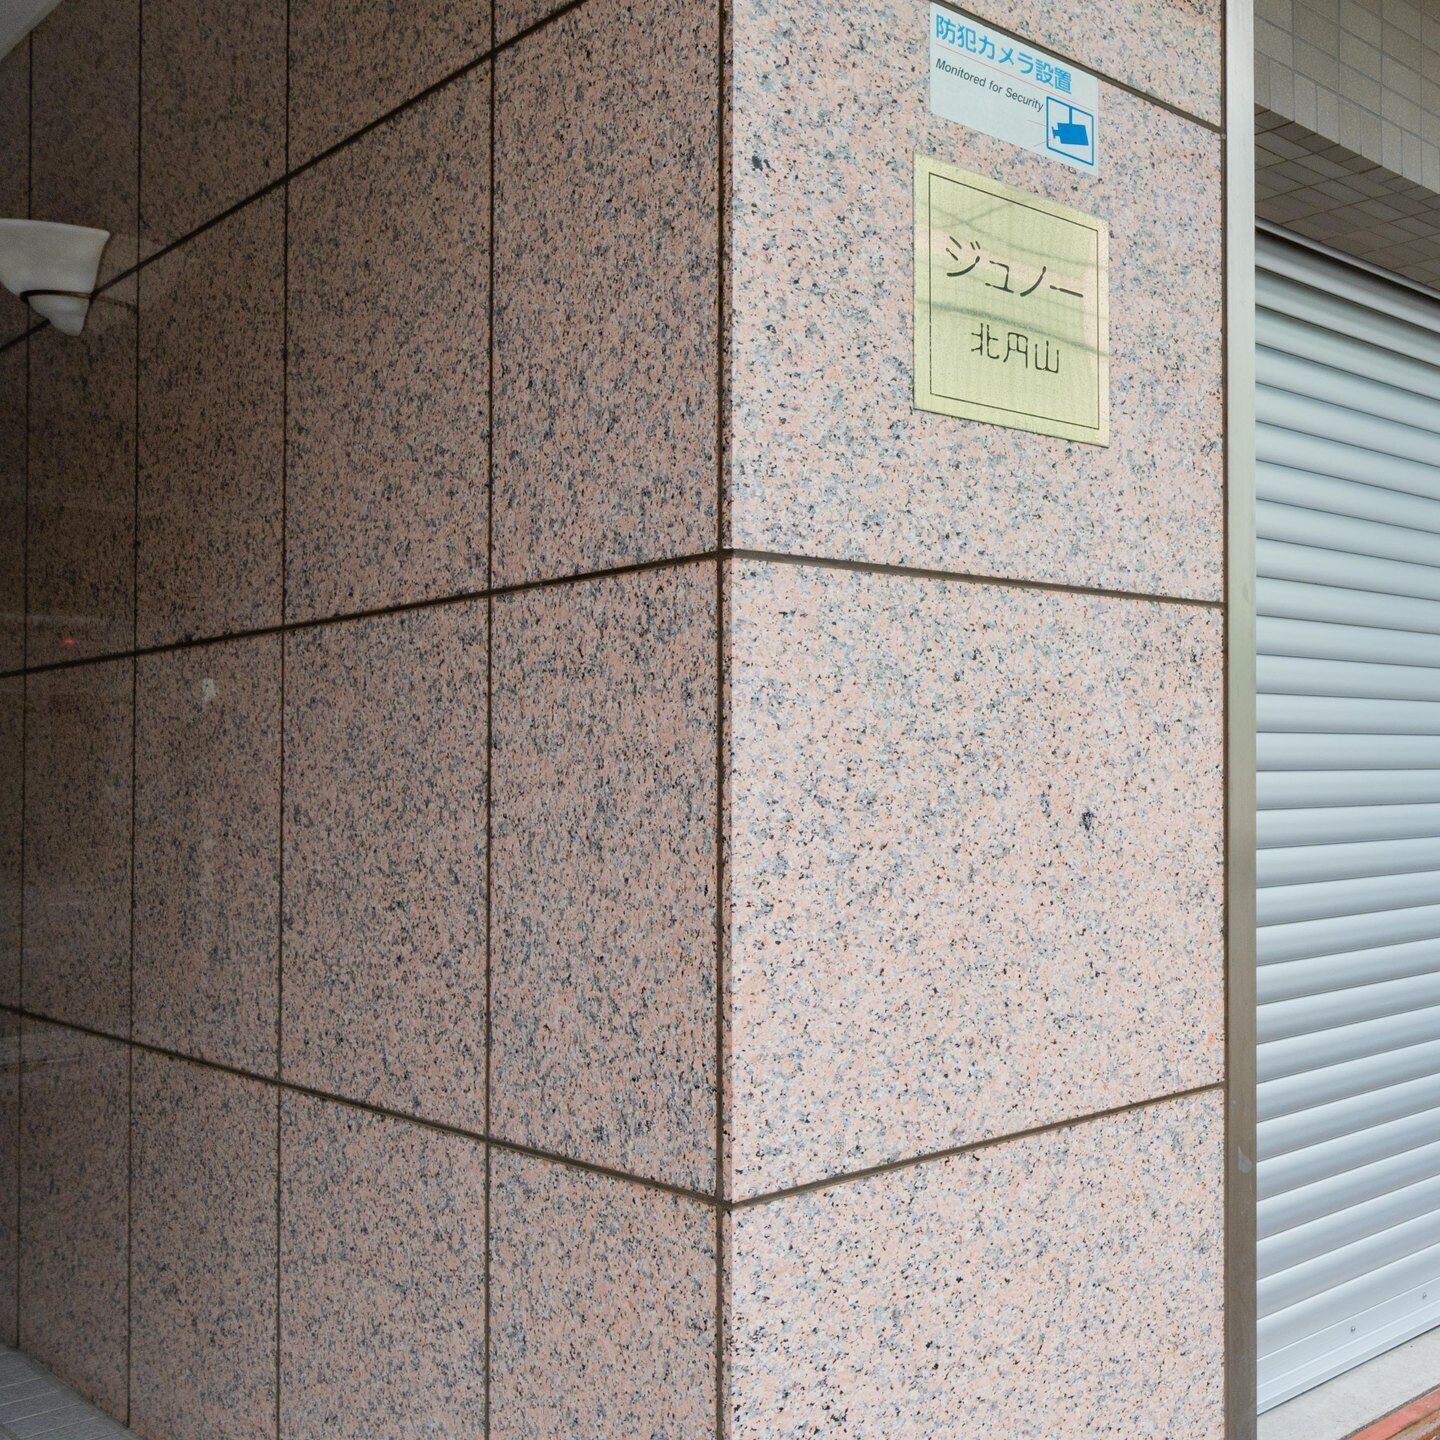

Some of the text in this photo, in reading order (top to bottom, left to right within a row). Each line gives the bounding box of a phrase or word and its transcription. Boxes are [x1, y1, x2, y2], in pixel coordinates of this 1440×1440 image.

[936, 14, 1072, 94] 防犯カメラ設置
[936, 58, 1044, 113] Monitored for Security
[945, 235, 1084, 298] ジュノー
[971, 322, 1060, 374] 北円山
